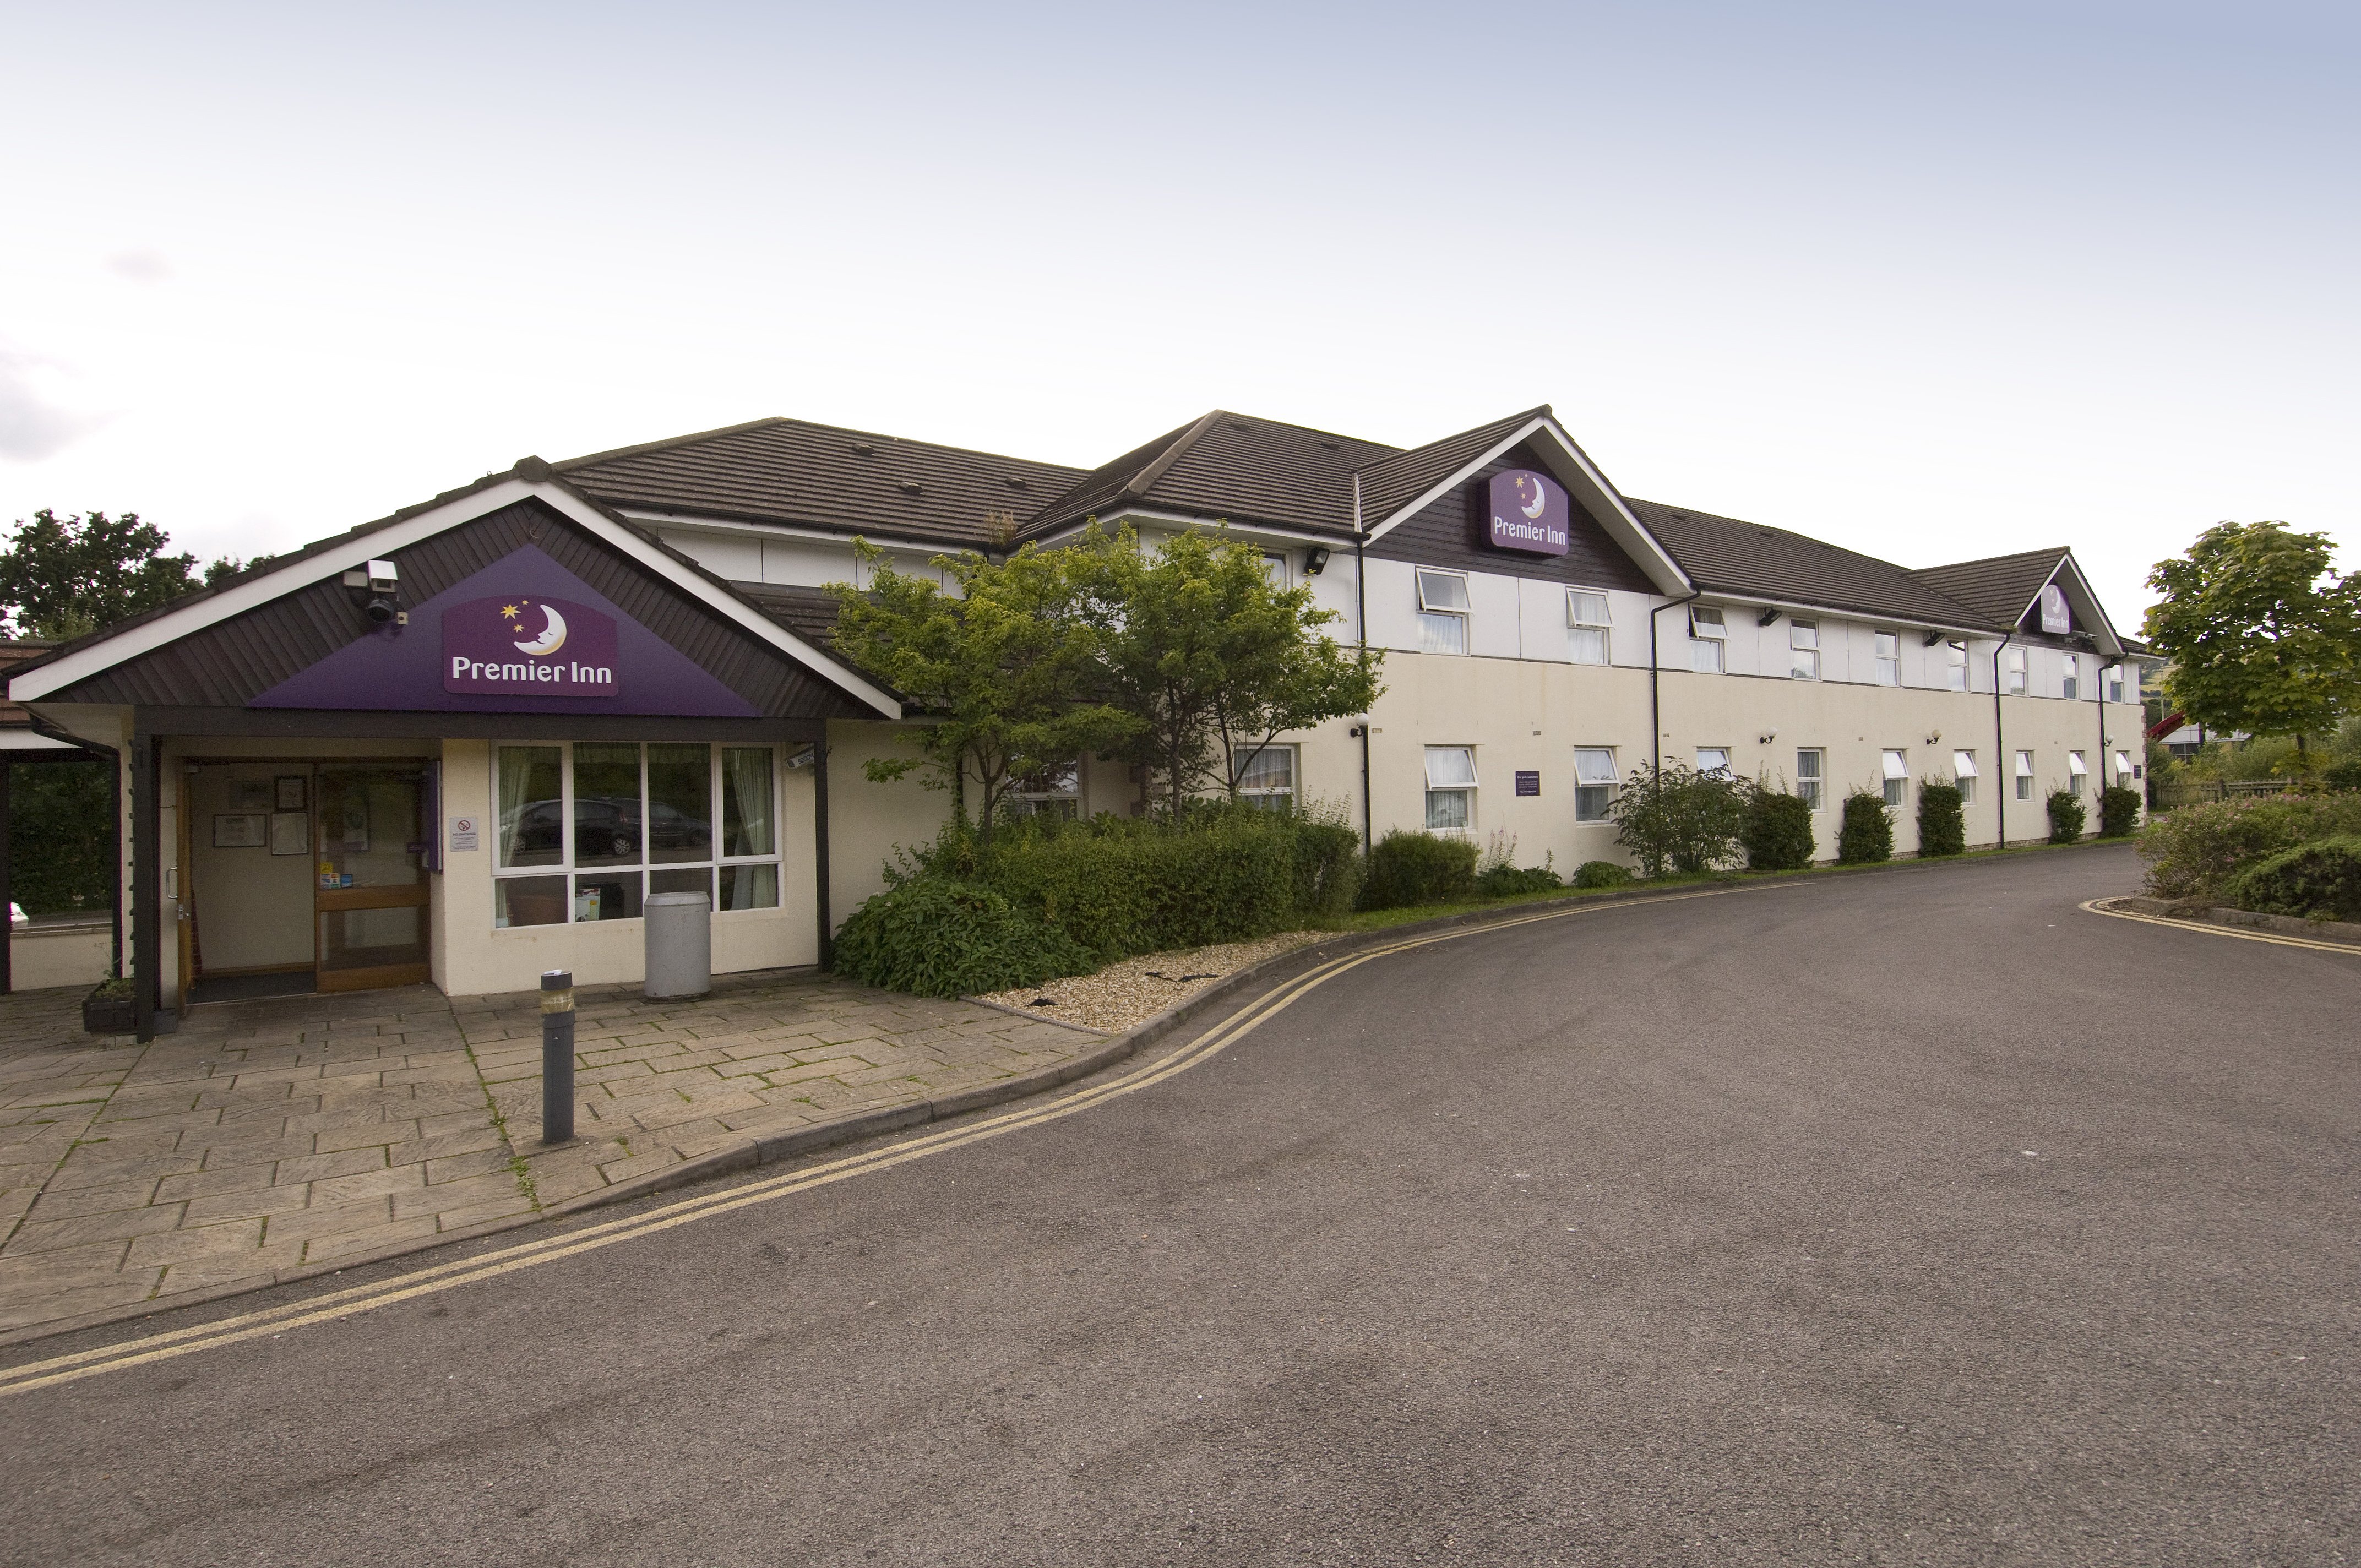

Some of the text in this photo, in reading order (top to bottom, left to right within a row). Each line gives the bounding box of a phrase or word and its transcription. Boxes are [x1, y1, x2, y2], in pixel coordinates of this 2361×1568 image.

[1494, 516, 1566, 546] Premier Inn
[2042, 613, 2061, 627] Premier
[453, 656, 611, 683] Premier Inn
